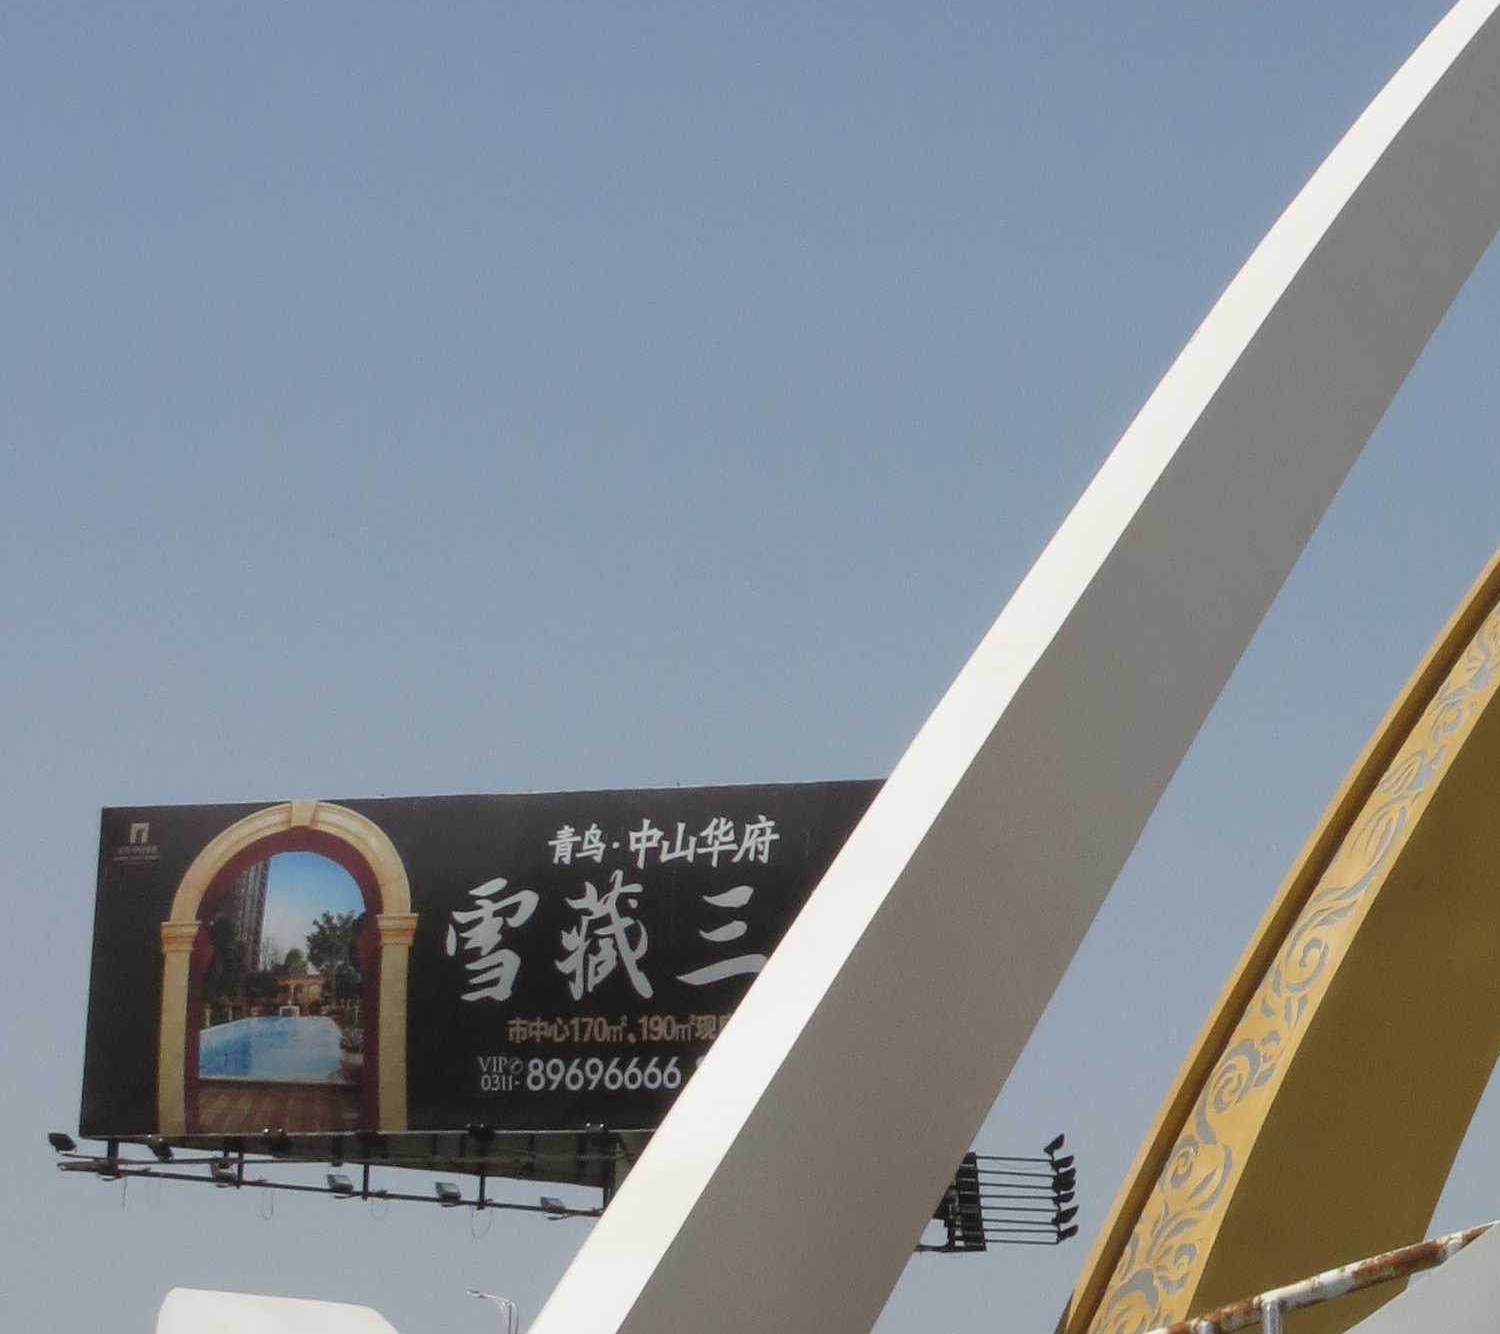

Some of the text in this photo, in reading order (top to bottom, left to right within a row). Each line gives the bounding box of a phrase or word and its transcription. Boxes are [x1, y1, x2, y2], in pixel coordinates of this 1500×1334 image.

[547, 815, 780, 869] 青鸟·中山华府
[477, 1056, 509, 1073] VIP
[526, 1056, 682, 1092] 89696666
